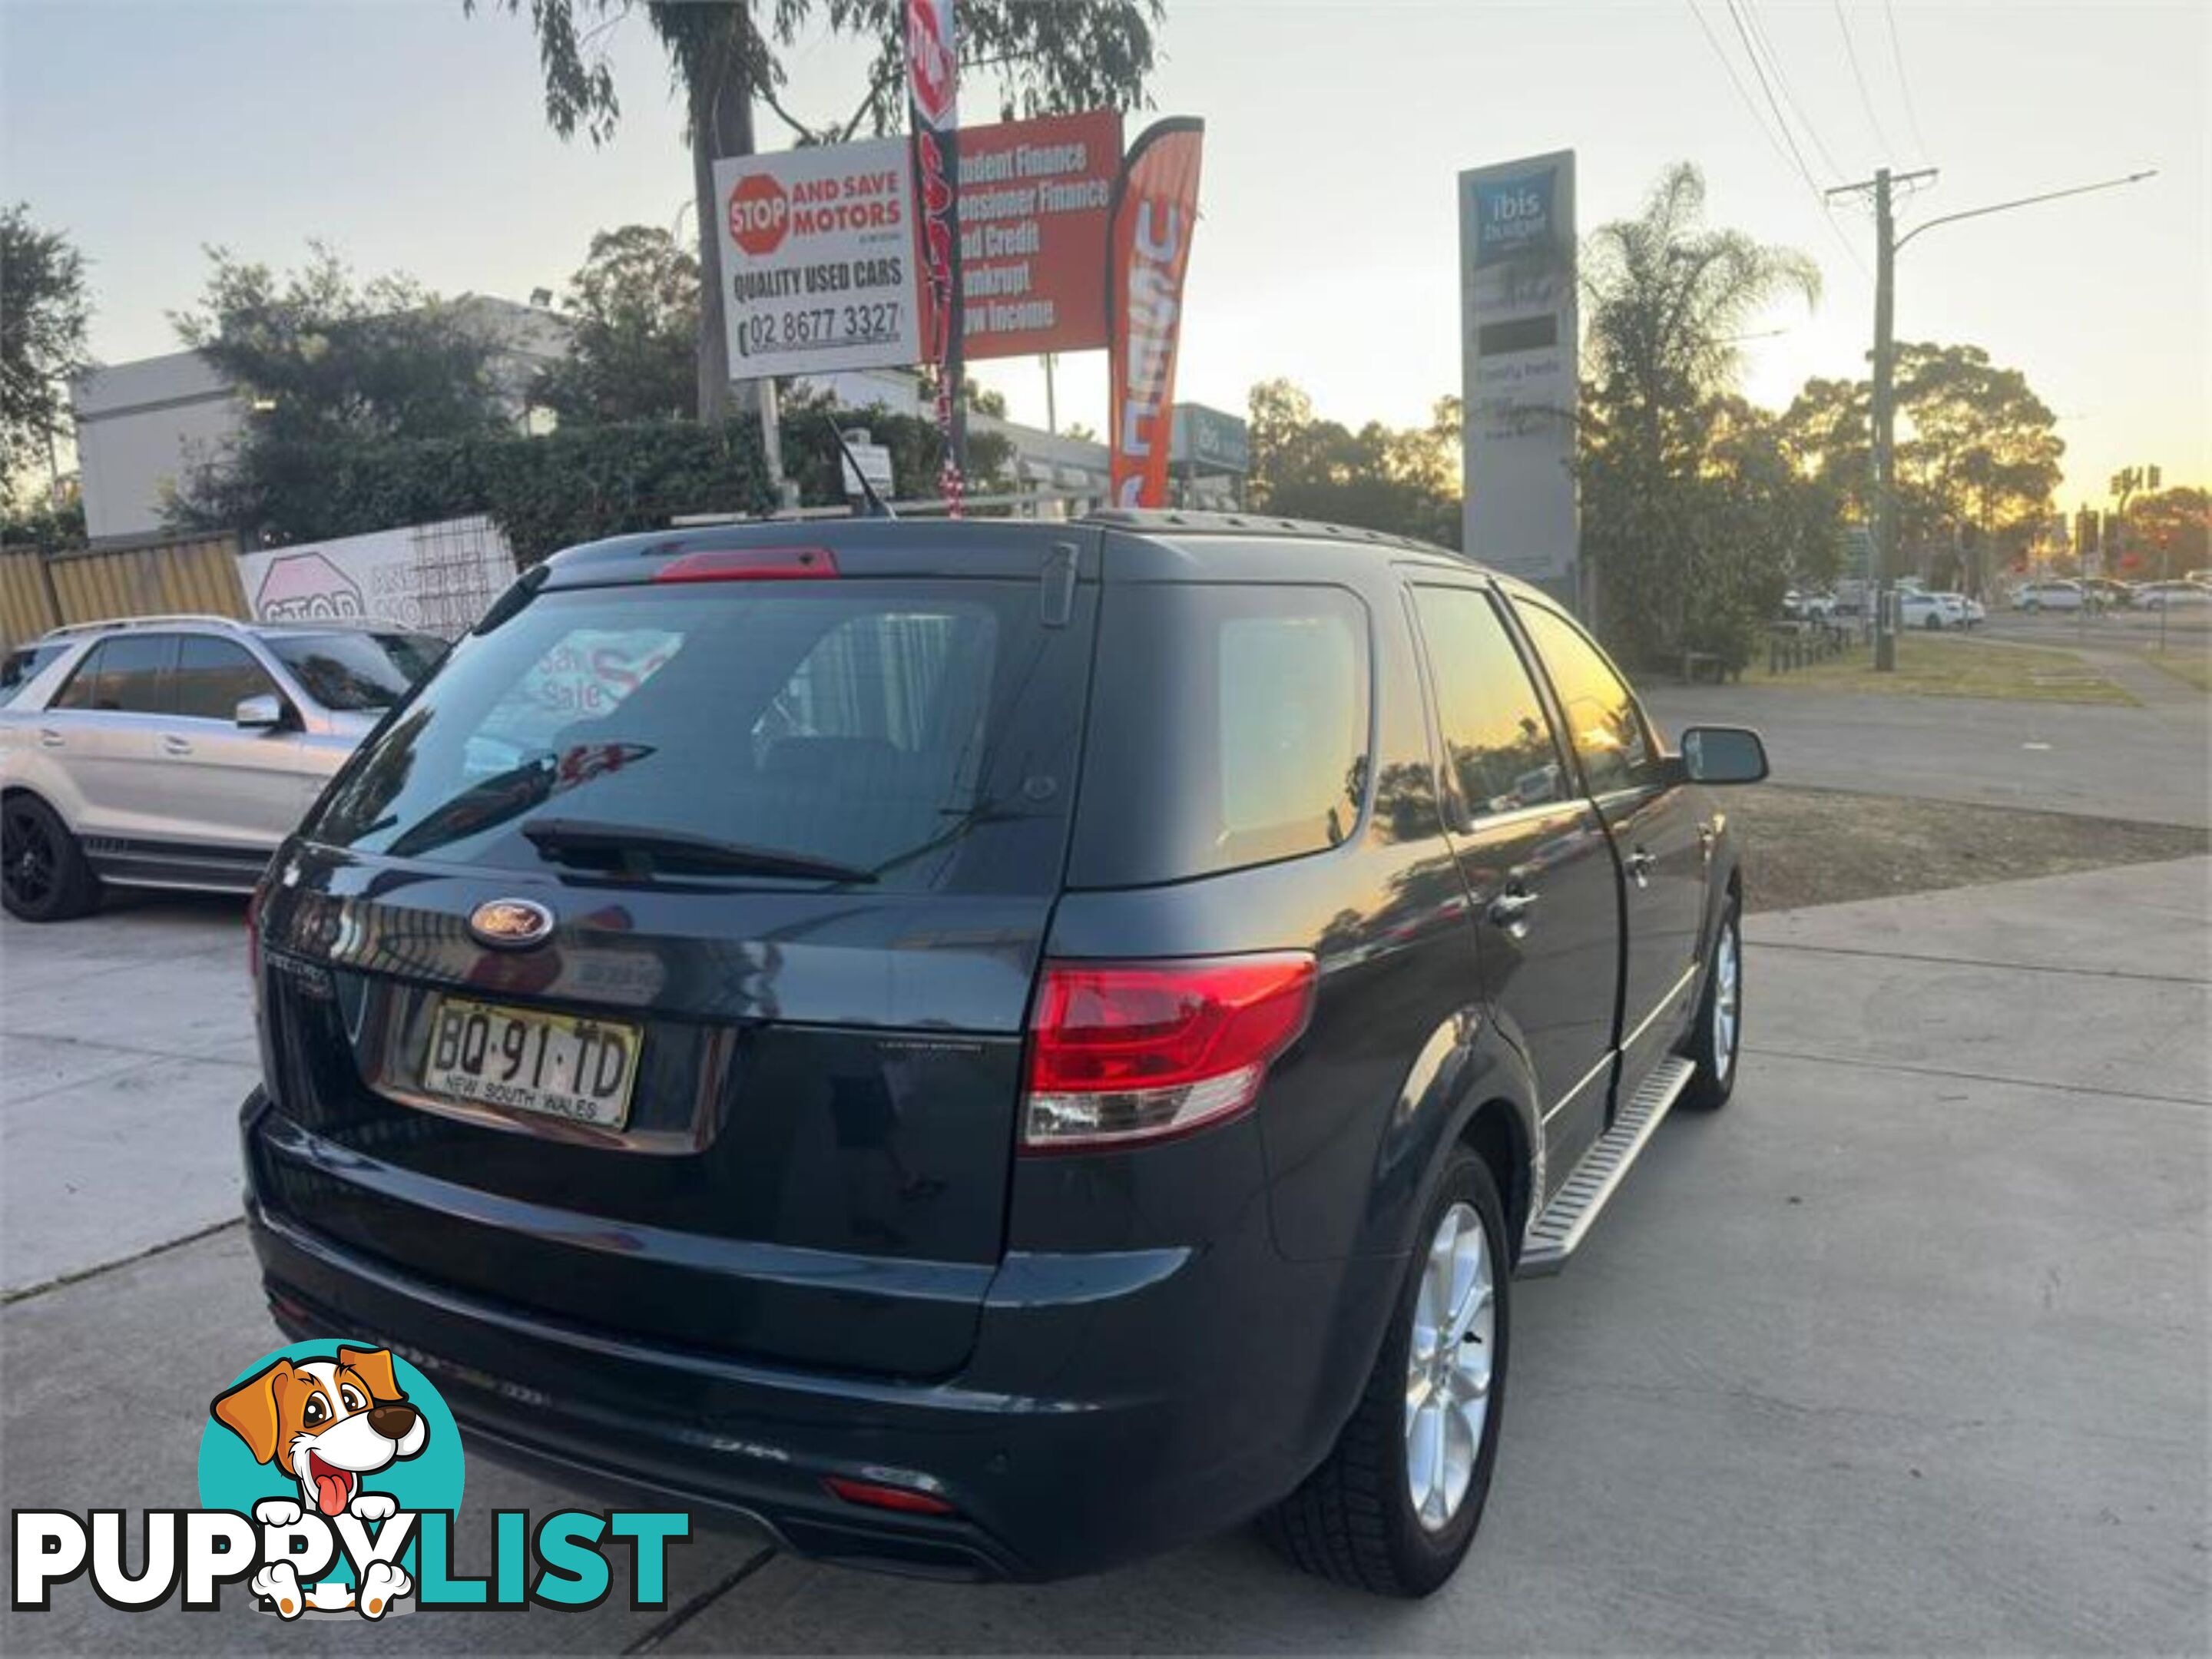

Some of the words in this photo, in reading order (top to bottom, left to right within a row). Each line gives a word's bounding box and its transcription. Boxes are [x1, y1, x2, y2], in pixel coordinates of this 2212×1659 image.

[1016, 144, 1087, 177] Finance
[793, 179, 839, 205] AND
[844, 172, 899, 197] SAVE
[1038, 179, 1109, 213] Finance
[730, 197, 786, 235] STOP
[793, 200, 901, 236] MOTORS
[961, 225, 982, 259] ad
[985, 219, 1039, 258] Credit
[734, 267, 802, 304] QUALITY
[806, 264, 849, 293] USED
[853, 257, 902, 290] CARS
[963, 260, 1031, 297] ankrupt
[750, 314, 776, 343] 02
[784, 309, 836, 341] 8677
[845, 303, 899, 335] 3327
[445, 1075, 479, 1095] NEW
[484, 1080, 538, 1109] SOUTH
[544, 1091, 598, 1121] WALES
